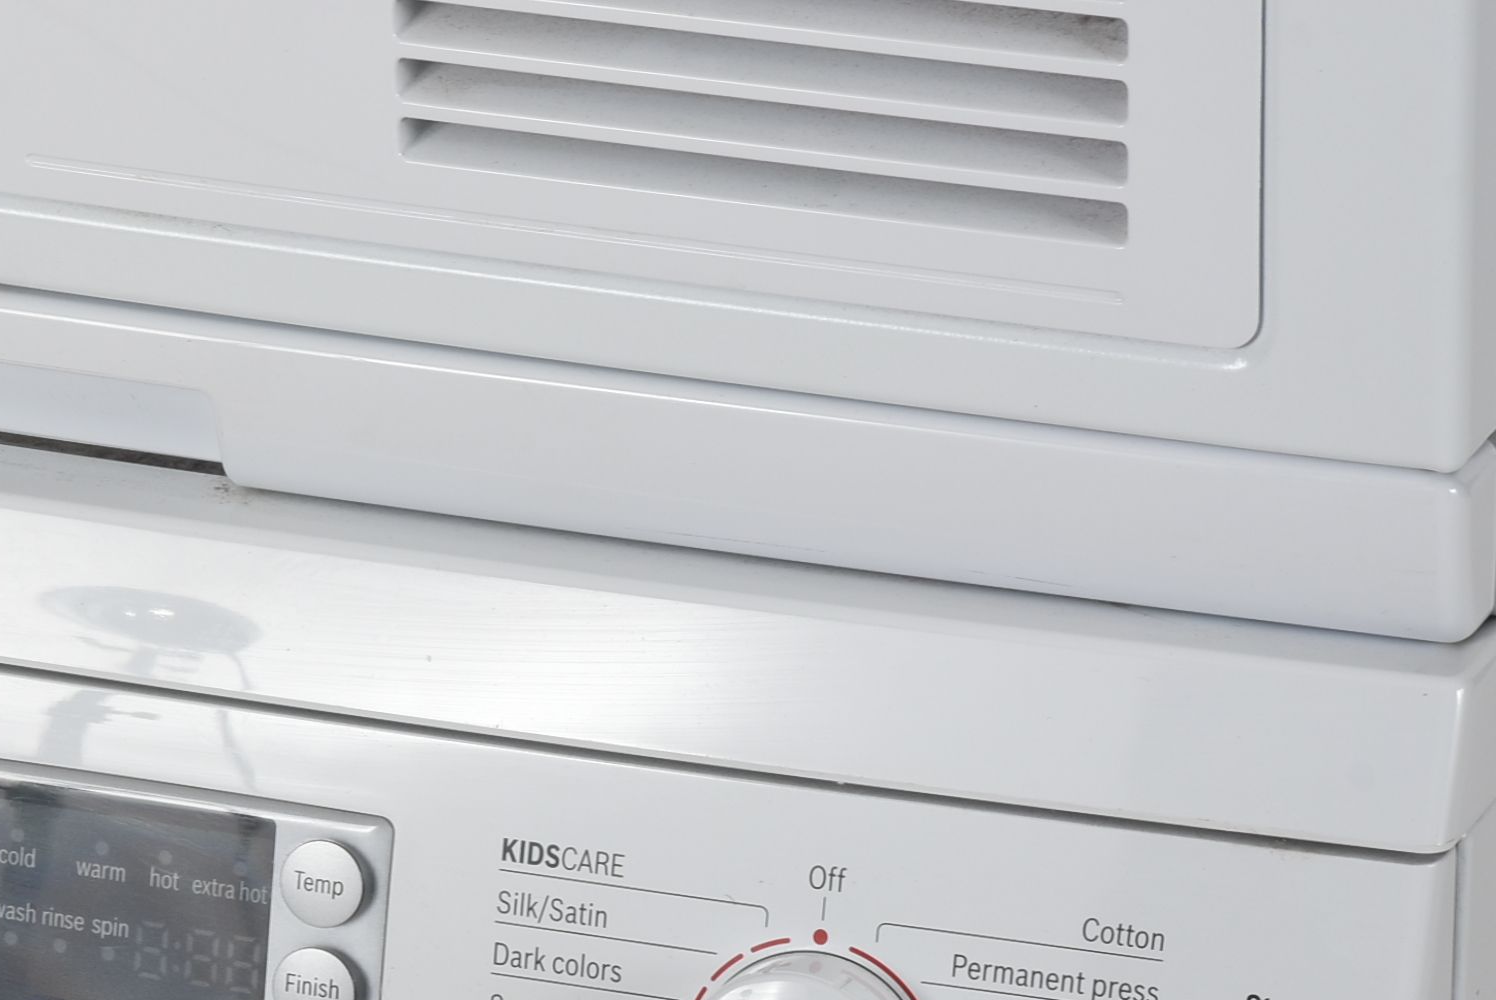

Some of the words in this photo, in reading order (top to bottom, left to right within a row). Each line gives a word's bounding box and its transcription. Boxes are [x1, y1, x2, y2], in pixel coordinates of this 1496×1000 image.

[76, 859, 126, 882] warm
[501, 838, 626, 878] KIDSCARE
[149, 867, 180, 891] hot
[192, 878, 235, 899] extra
[240, 879, 268, 905] hot
[294, 870, 344, 899] Temp
[808, 865, 847, 892] Off
[42, 910, 85, 931] rinse
[496, 890, 608, 928] Silk/Satin
[91, 916, 129, 939] spin
[1082, 918, 1166, 952] Cotton
[492, 942, 546, 972] Dark
[551, 953, 623, 982] colors
[952, 954, 1085, 996] Permanent
[285, 973, 340, 1000] Finish
